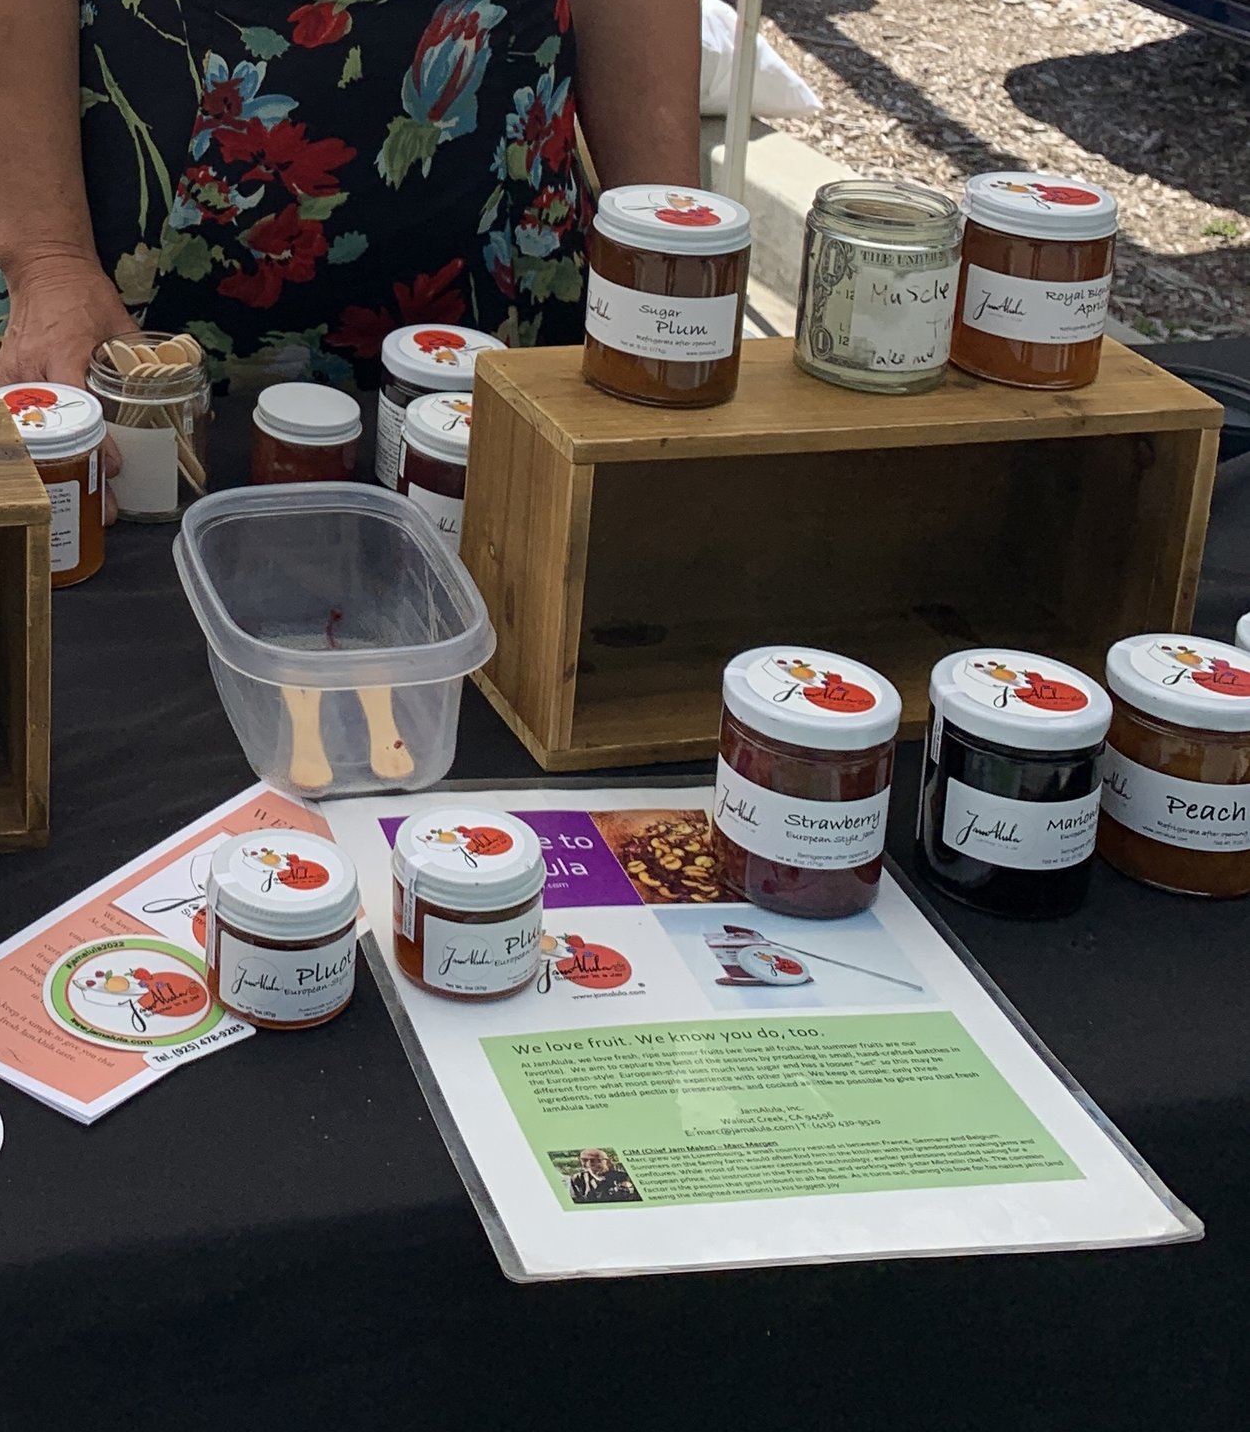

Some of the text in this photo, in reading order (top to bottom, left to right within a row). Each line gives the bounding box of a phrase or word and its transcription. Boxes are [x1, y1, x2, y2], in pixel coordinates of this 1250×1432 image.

[1046, 290, 1084, 306] Royal
[639, 305, 682, 318] Sugar
[655, 320, 707, 335] Plum
[1166, 794, 1246, 823] Peach
[783, 810, 881, 830] Strawberry
[956, 809, 1023, 846] JamAlula
[558, 834, 594, 849] to
[785, 830, 832, 844] European
[296, 948, 352, 986] Pluot
[29, 1017, 53, 1036] simple
[152, 1024, 245, 1064] Tel. (925) 478-9285
[512, 1027, 825, 1055] We love fruit. We know you do, too.
[720, 1117, 755, 1125] Walnut
[757, 1115, 787, 1124] Creek,
[788, 1113, 803, 1121] CA
